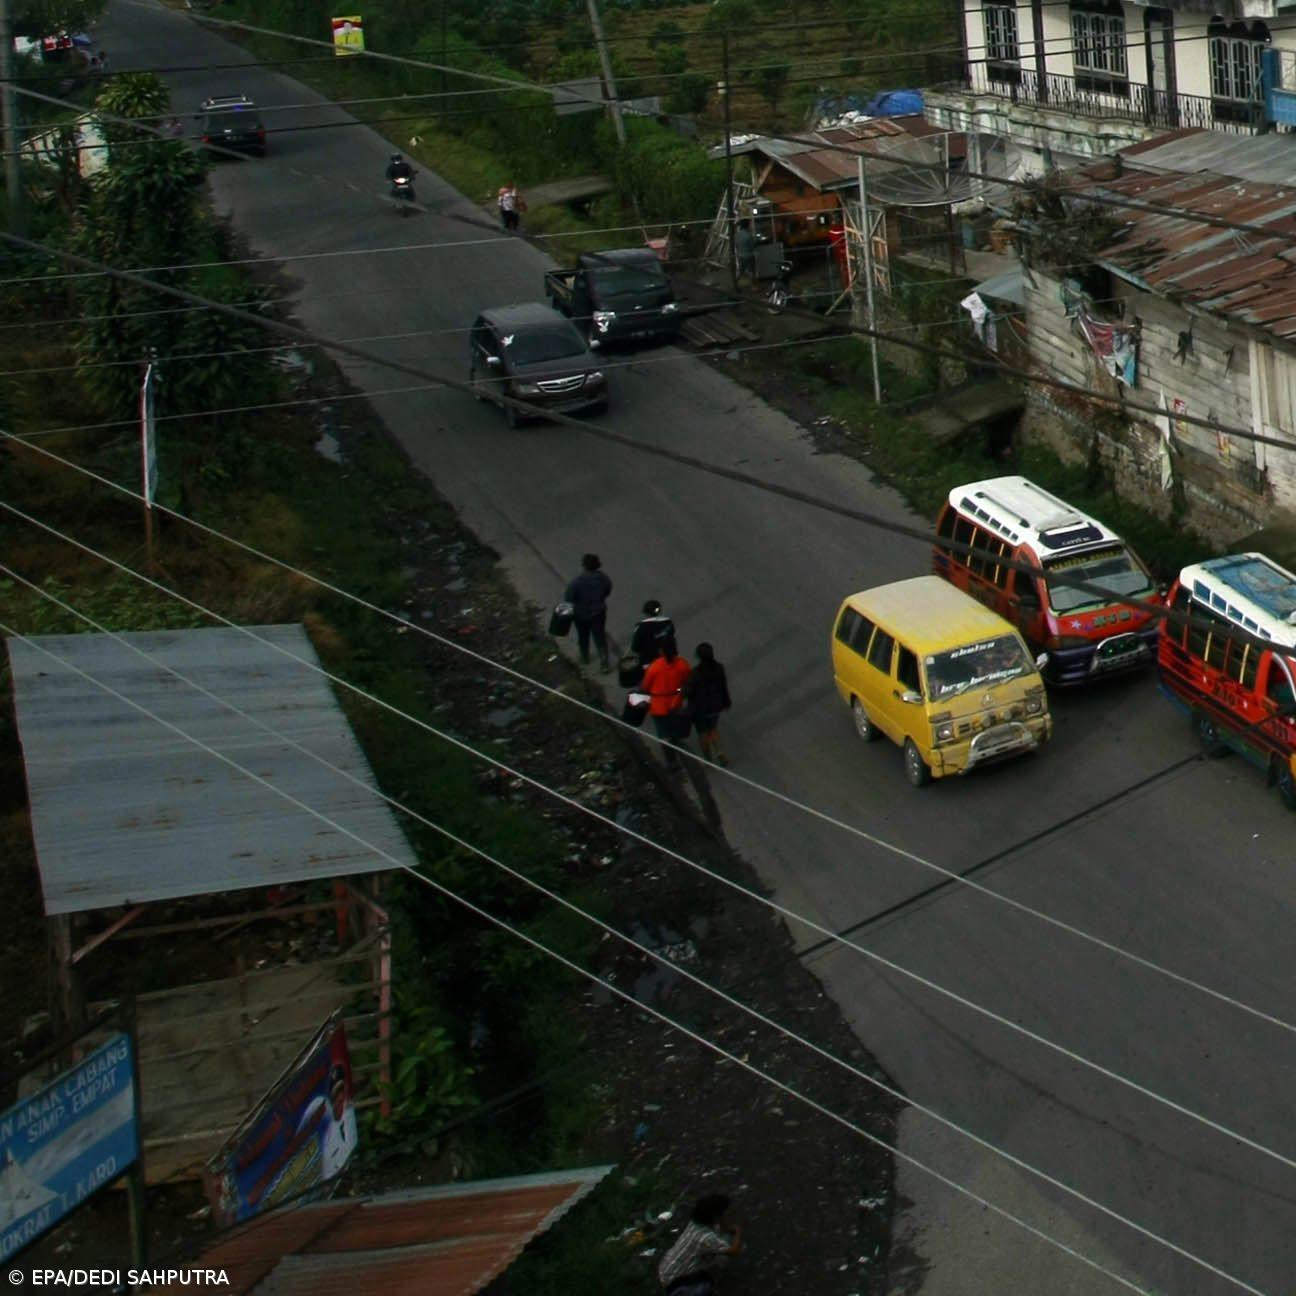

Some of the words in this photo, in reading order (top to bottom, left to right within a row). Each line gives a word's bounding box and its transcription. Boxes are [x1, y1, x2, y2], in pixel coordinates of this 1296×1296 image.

[16, 1091, 60, 1132] ANAK
[65, 1039, 128, 1099] CABANG
[72, 1066, 117, 1115] EMPAT
[0, 1206, 51, 1260] OKRAT
[76, 1154, 117, 1203] KARO
